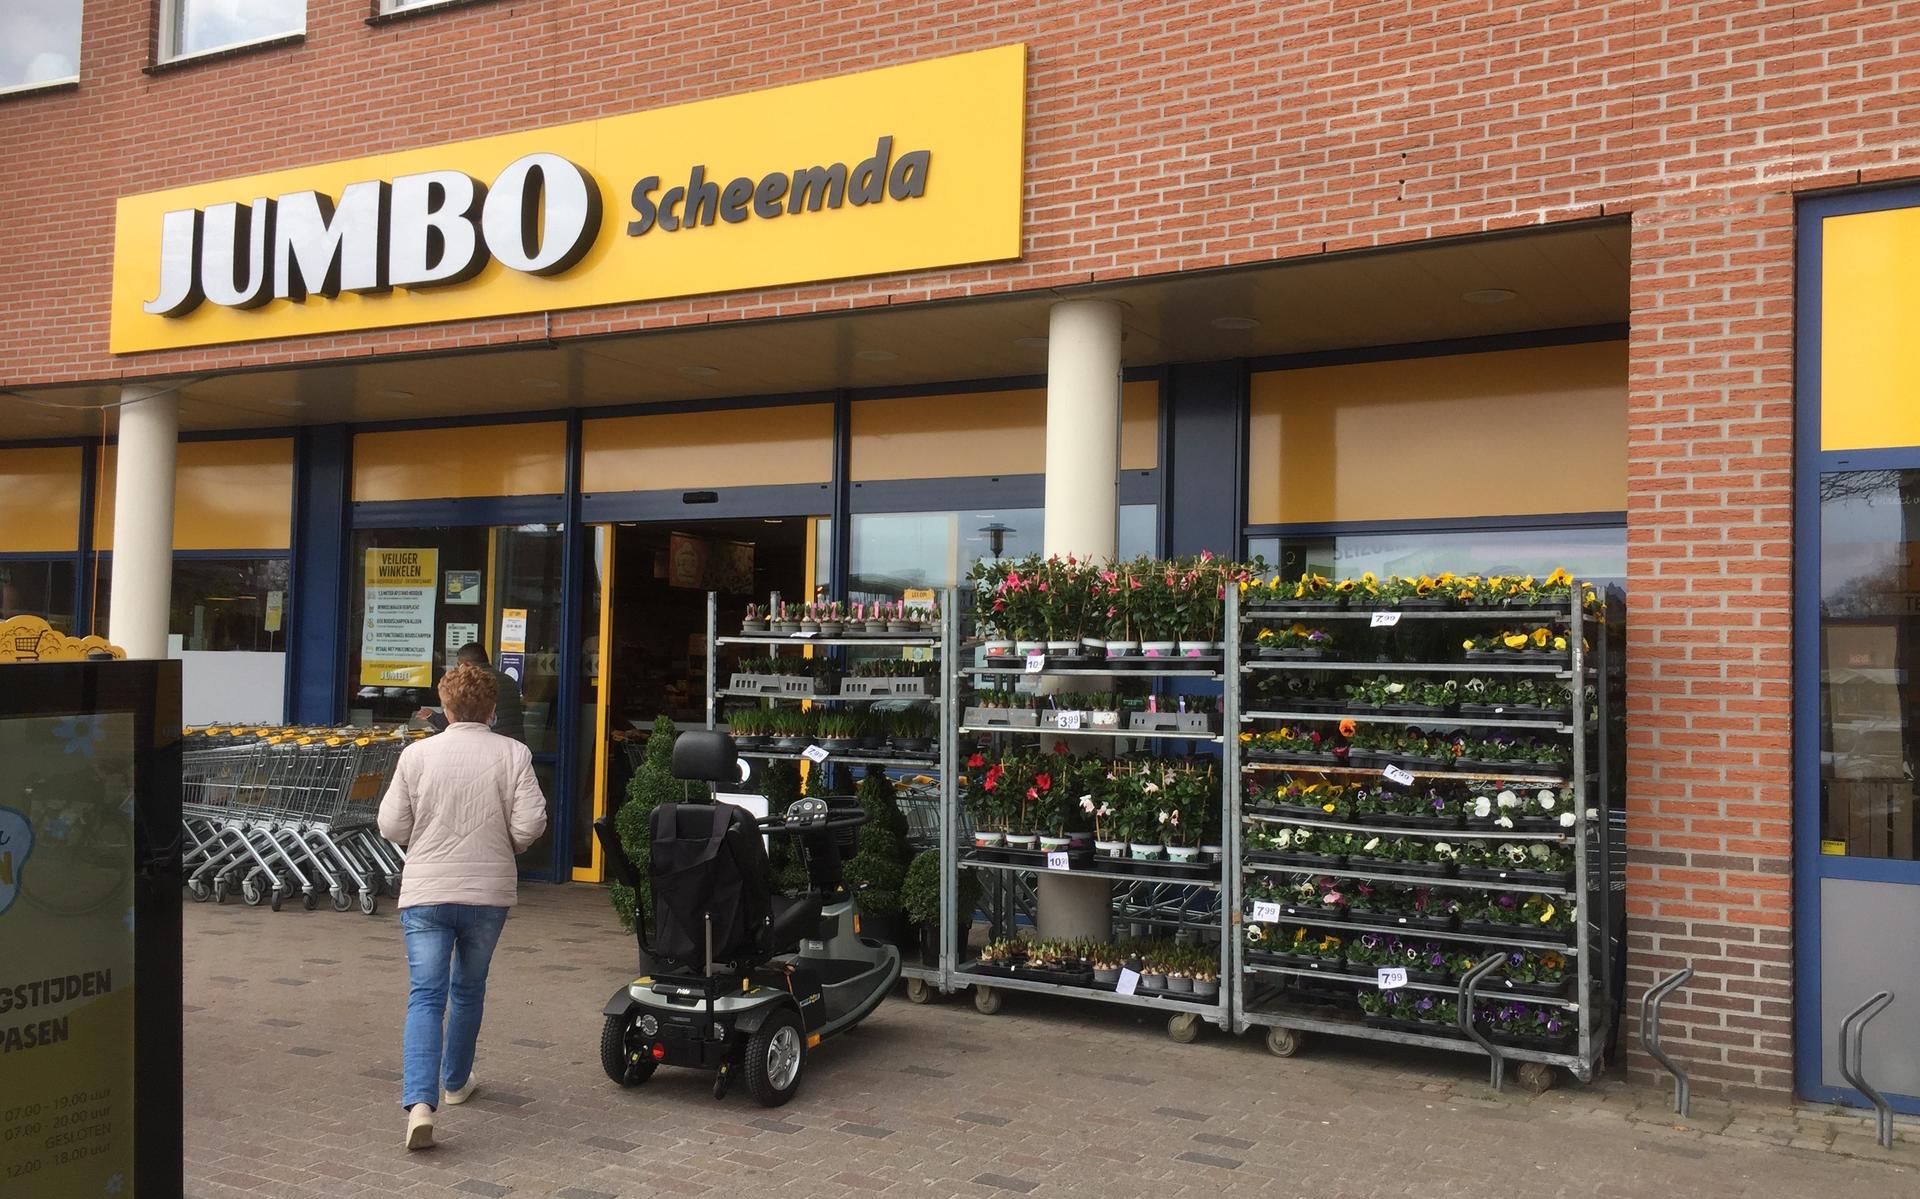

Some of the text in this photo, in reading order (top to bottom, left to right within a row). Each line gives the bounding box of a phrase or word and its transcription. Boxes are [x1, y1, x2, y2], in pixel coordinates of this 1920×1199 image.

[143, 135, 931, 317] JUMBO Scheemda
[382, 552, 418, 565] VEILIGER
[379, 565, 421, 577] WINKELEN
[1376, 614, 1396, 623] 7,99
[1060, 715, 1079, 728] 3,99
[1390, 767, 1410, 780] 7,99
[1257, 906, 1275, 918] 7,99
[1381, 973, 1402, 985] 7,99
[5, 1103, 41, 1122] 07.00
[54, 1092, 88, 1110] 19.00
[90, 1089, 112, 1101] uur
[4, 1122, 41, 1141] 07.00
[53, 1110, 88, 1129] 20.00
[90, 1106, 112, 1119] uur
[45, 1123, 112, 1149] GESLOTEN
[7, 1160, 41, 1178] 12.00
[90, 1143, 112, 1156] uur
